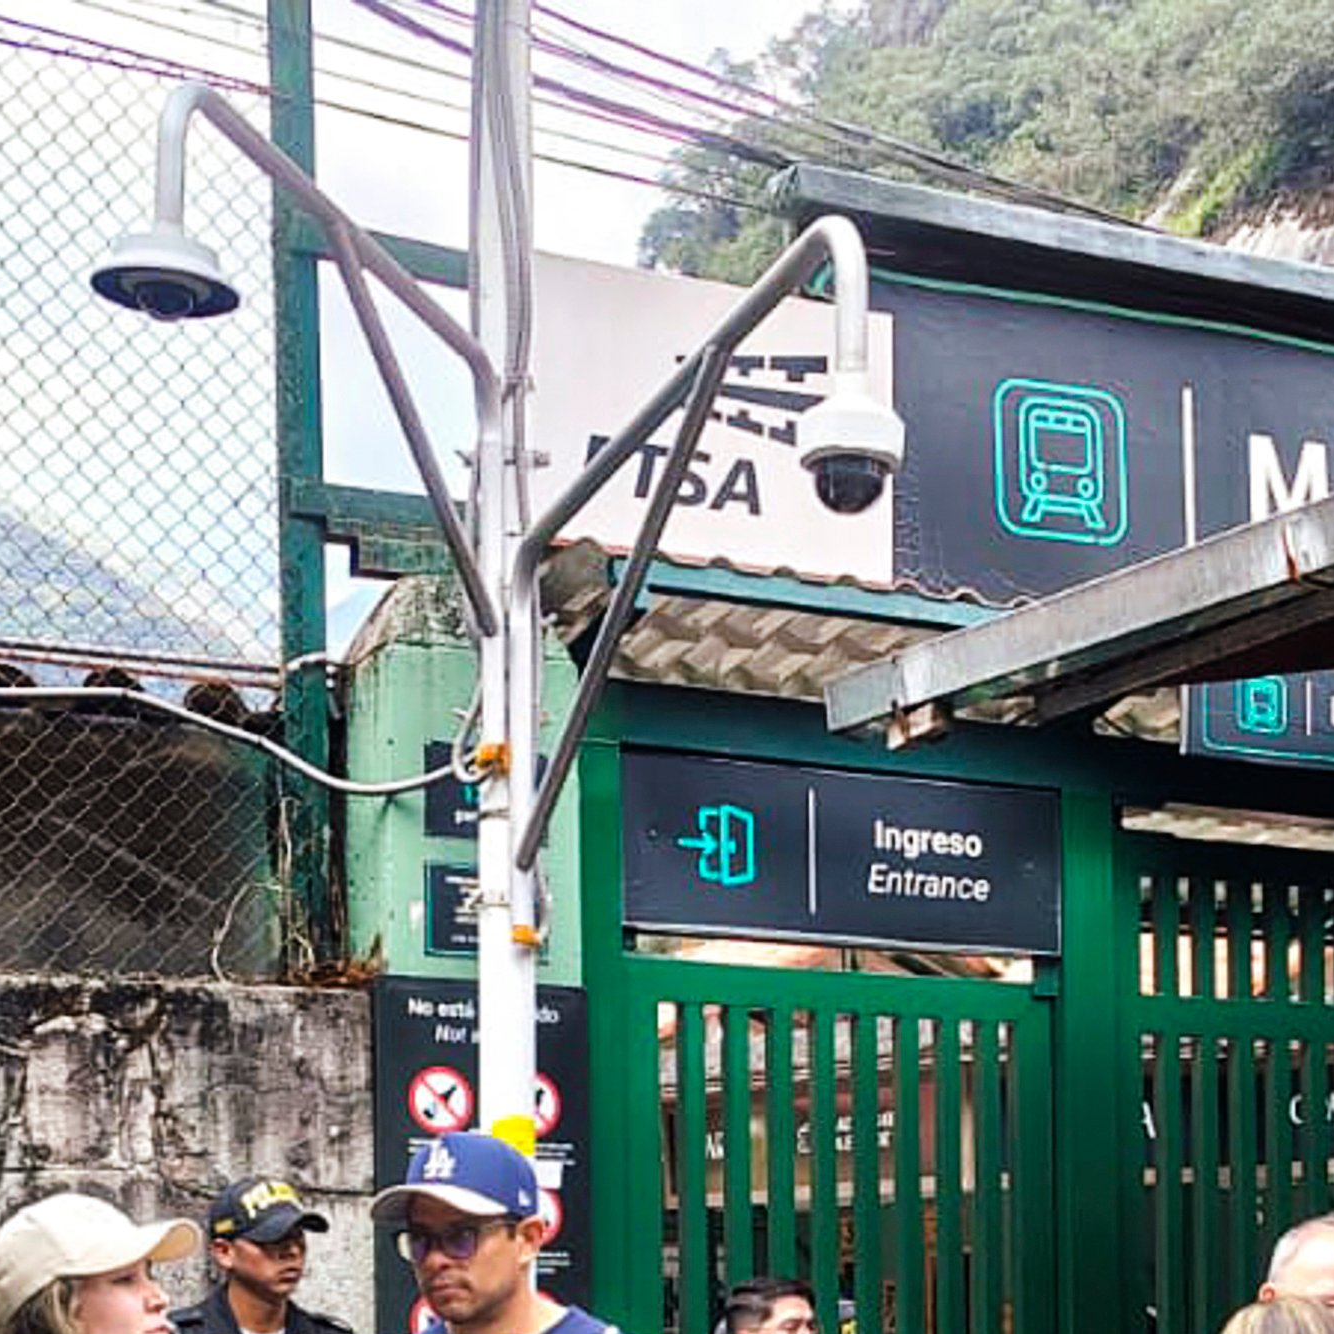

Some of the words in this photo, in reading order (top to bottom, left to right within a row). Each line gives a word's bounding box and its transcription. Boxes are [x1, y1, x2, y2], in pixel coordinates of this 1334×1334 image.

[873, 819, 983, 859] Ingreso
[867, 863, 991, 902] Entrance
[408, 998, 434, 1016] No
